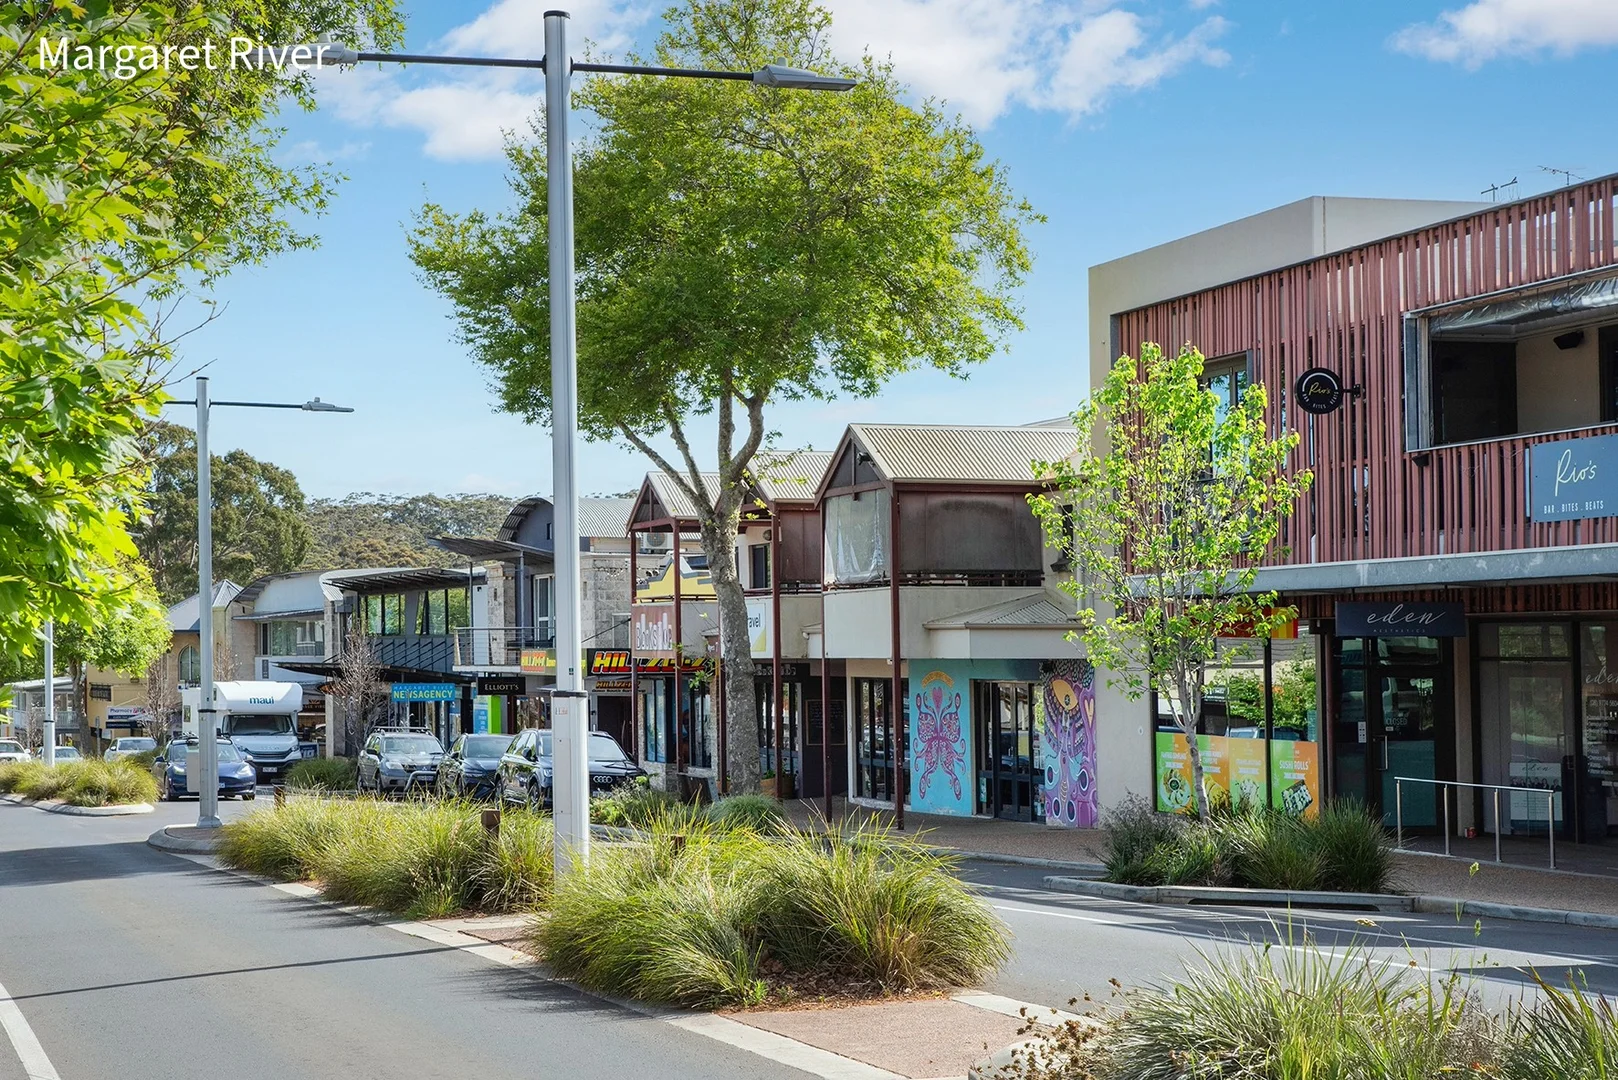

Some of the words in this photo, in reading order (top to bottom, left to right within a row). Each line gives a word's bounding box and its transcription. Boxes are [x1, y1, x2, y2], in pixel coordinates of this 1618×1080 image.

[1555, 449, 1597, 497] Rio's
[1543, 504, 1555, 514] BAR
[1561, 502, 1579, 512] BITES
[1585, 500, 1604, 511] BEATS
[1366, 604, 1446, 625] eden
[484, 683, 519, 691] ELLIOTT'S
[393, 690, 453, 699] NEWSAGENCY
[249, 696, 275, 705] maui
